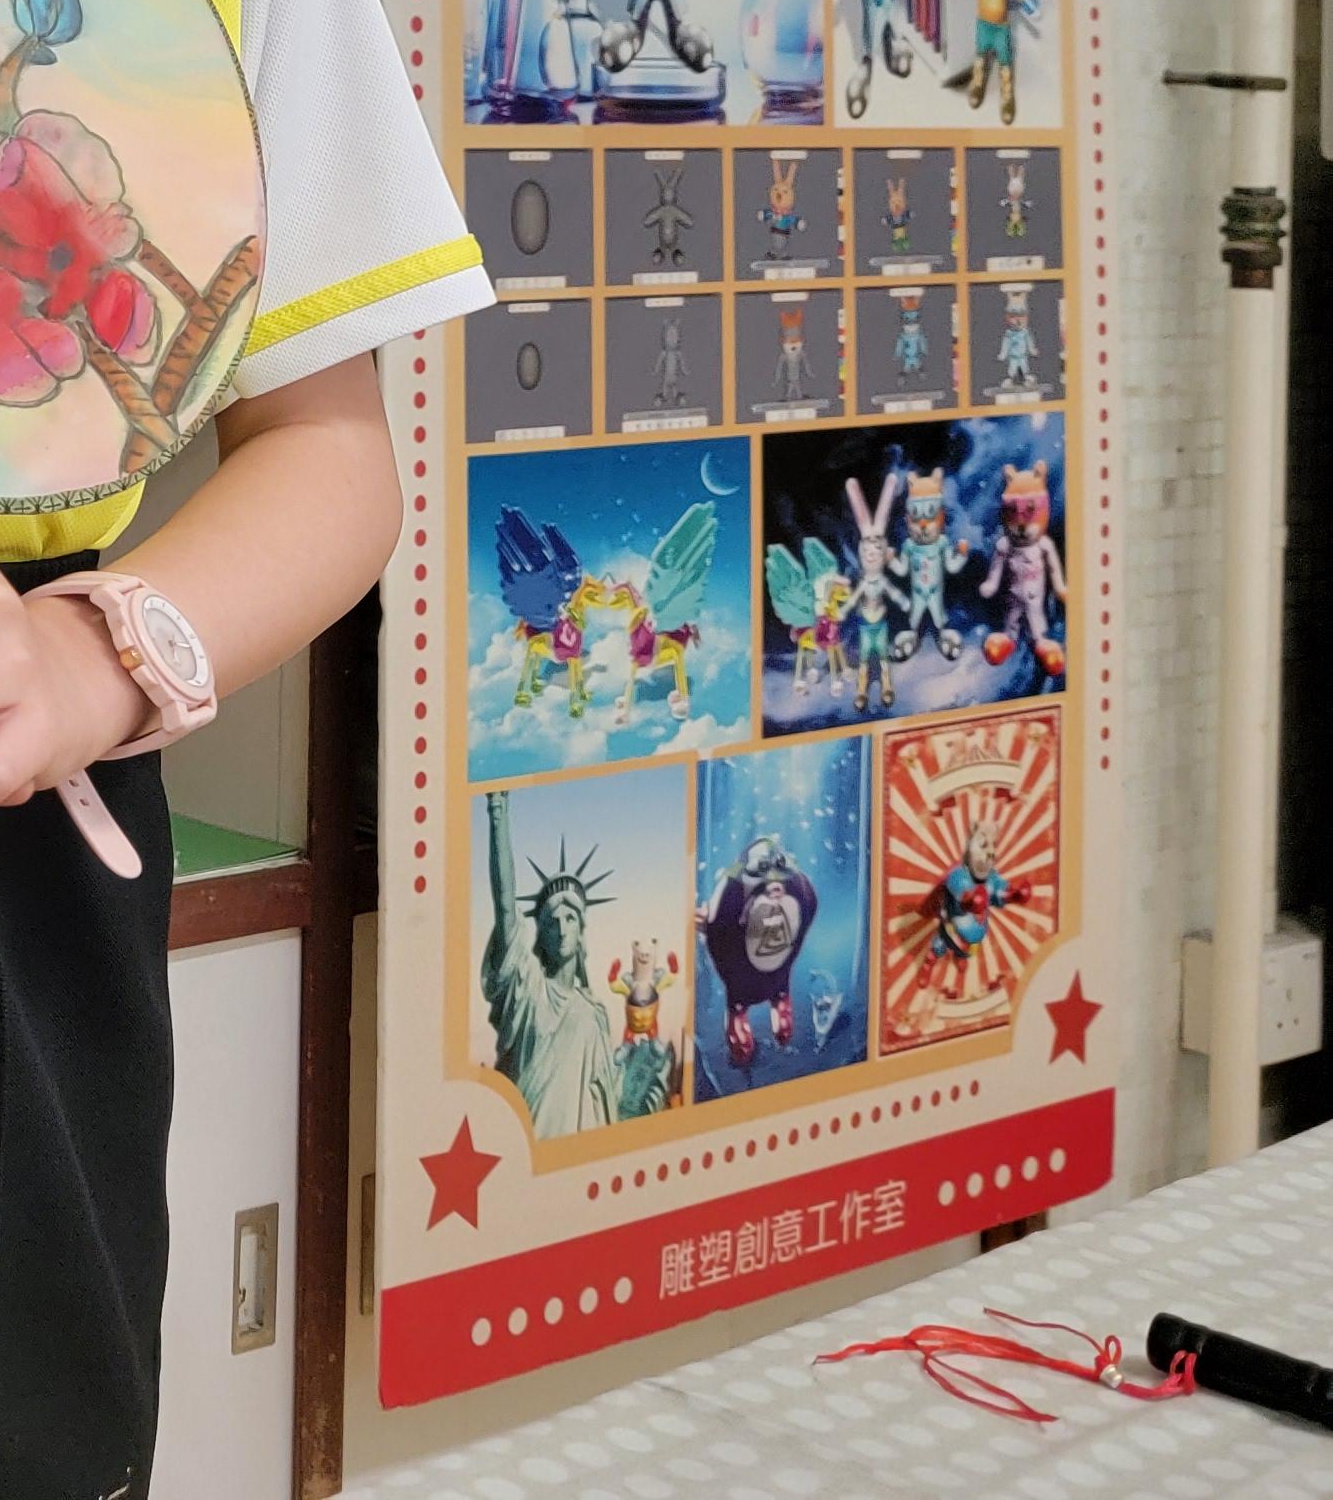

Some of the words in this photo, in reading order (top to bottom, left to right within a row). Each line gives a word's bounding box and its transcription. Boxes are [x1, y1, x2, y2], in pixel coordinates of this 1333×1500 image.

[659, 1180, 907, 1300] 雕塑創意工作室
